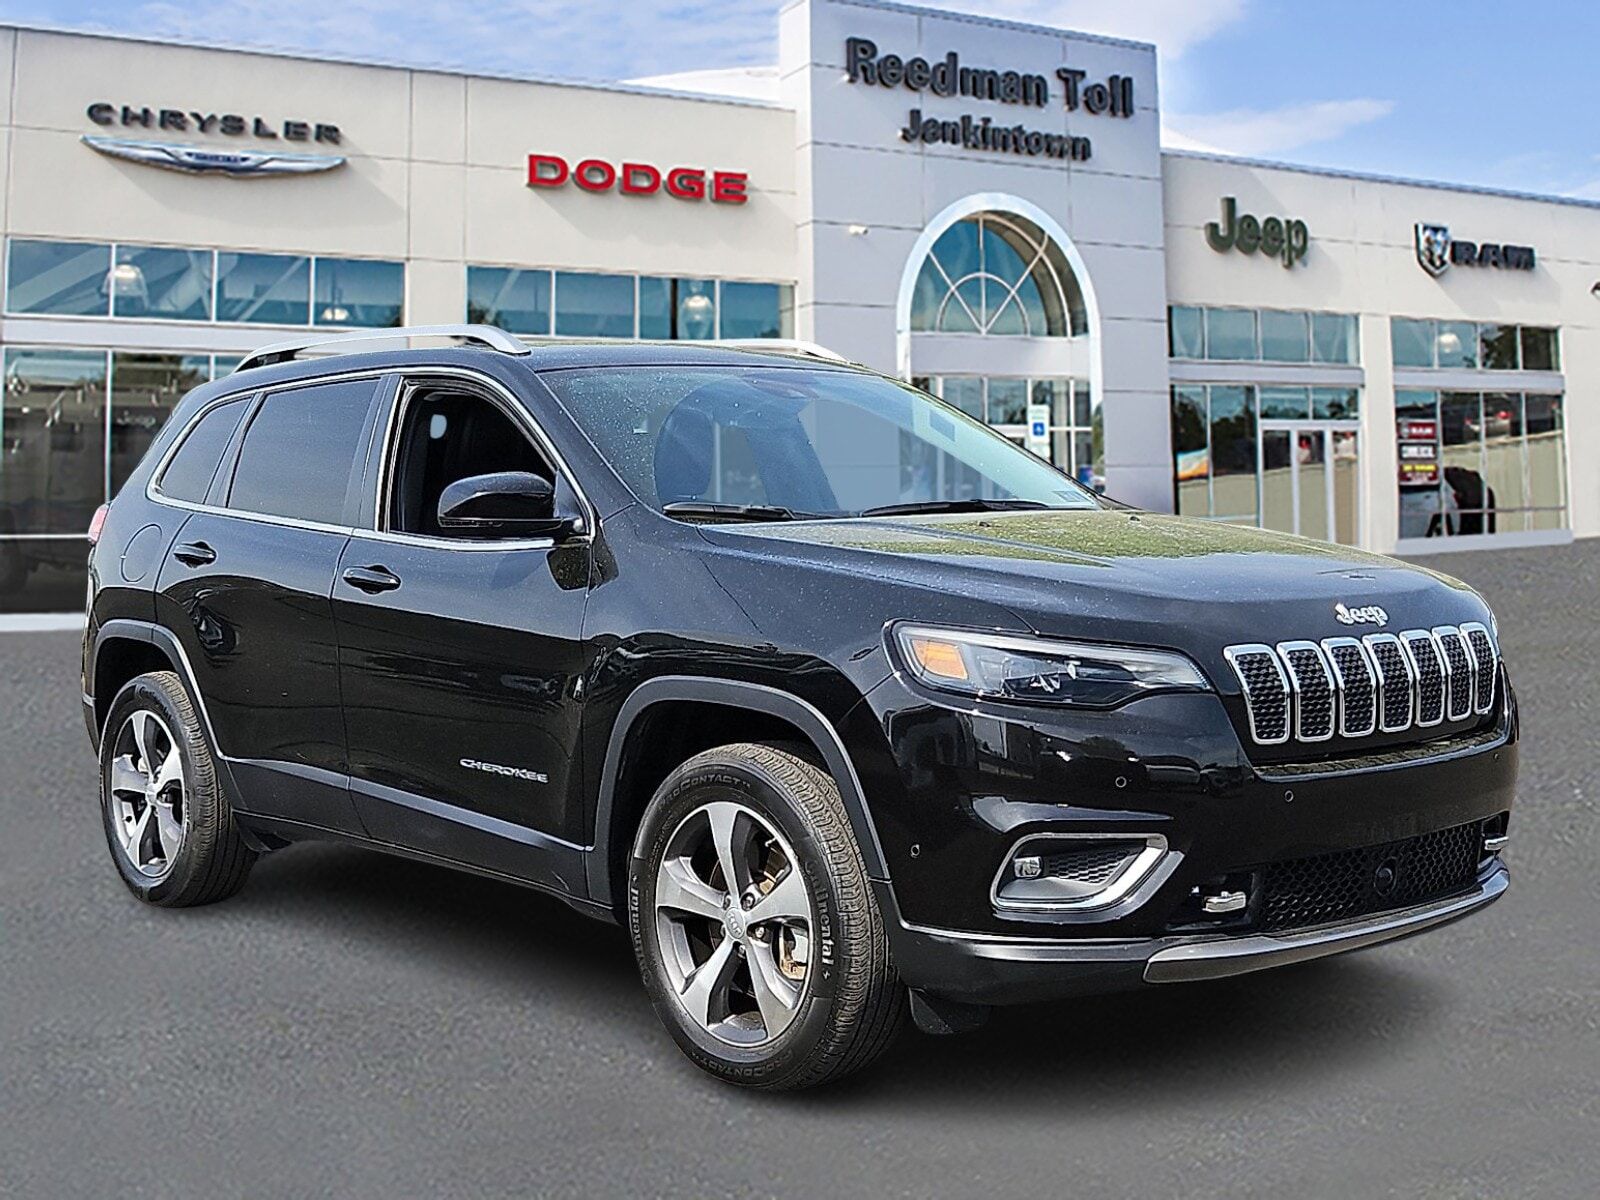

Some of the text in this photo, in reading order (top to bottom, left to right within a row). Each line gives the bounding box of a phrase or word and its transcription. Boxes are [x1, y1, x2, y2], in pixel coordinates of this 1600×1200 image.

[845, 37, 1134, 118] Reedman Toll
[87, 102, 341, 145] CHRYSLER
[901, 109, 1092, 161] Jenkintown
[527, 154, 749, 204] DODGE
[1205, 197, 1308, 269] Jeep
[1451, 241, 1535, 270] RAM
[1335, 603, 1388, 627] Jeep
[460, 759, 548, 783] CHEROKEE
